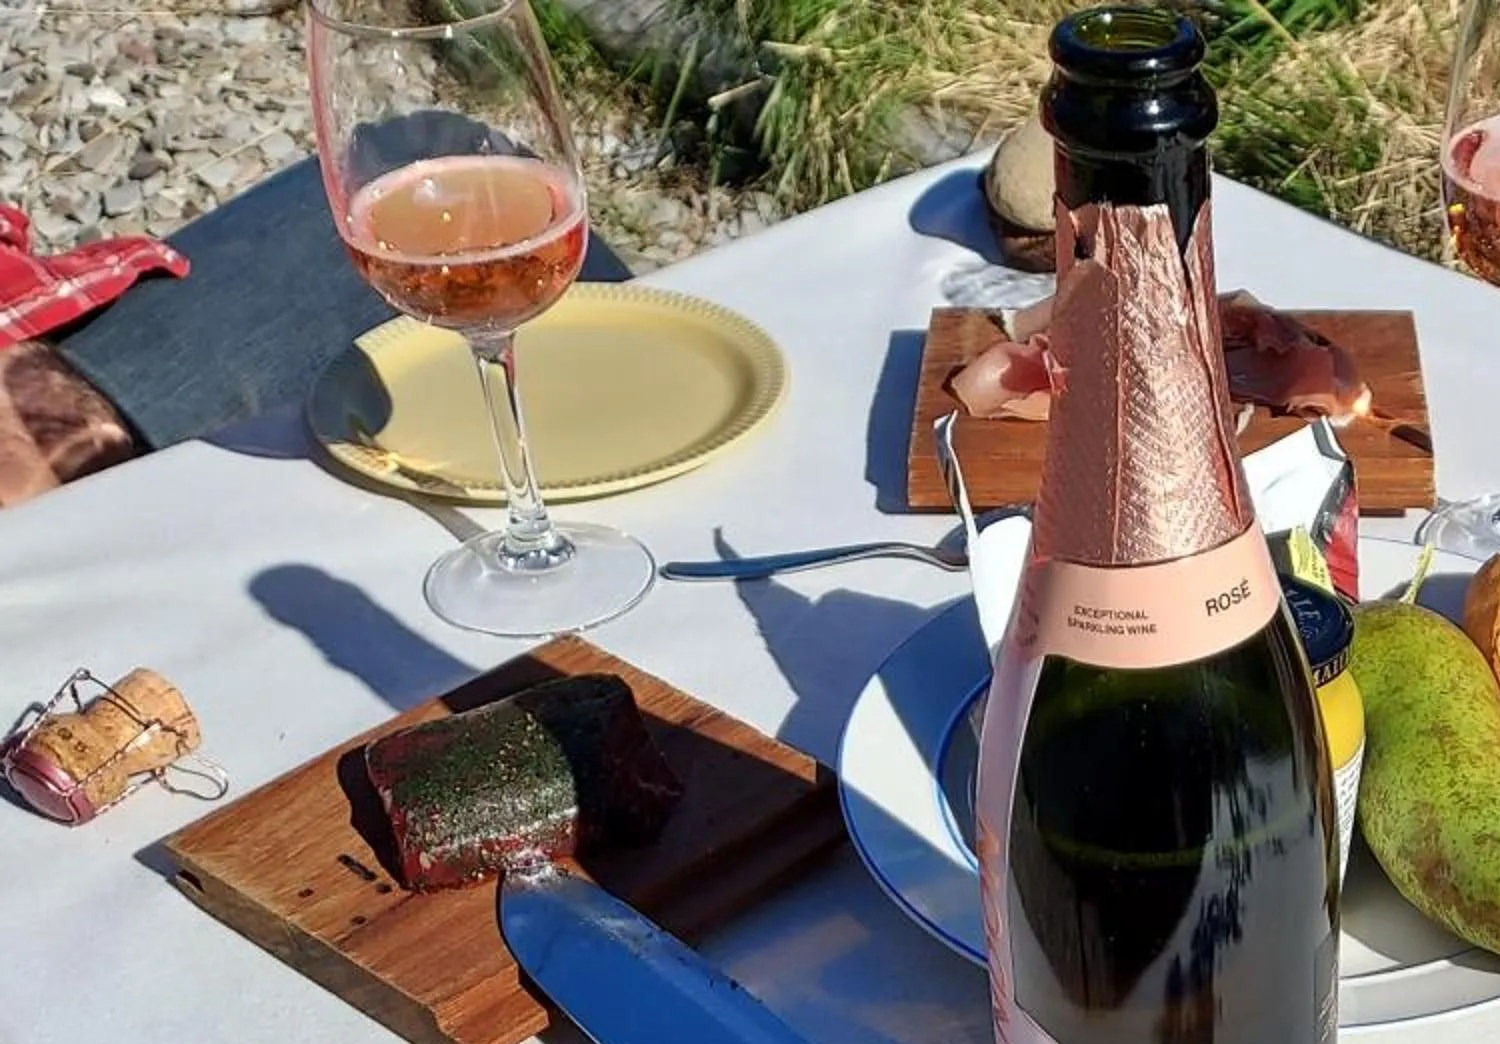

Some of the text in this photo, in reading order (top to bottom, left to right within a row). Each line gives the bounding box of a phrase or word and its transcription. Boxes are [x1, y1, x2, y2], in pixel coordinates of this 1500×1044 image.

[1205, 578, 1252, 617] ROSÉ
[1073, 605, 1149, 620] EXCEPTIONAL
[1067, 617, 1158, 635] SPARKLING WINE
